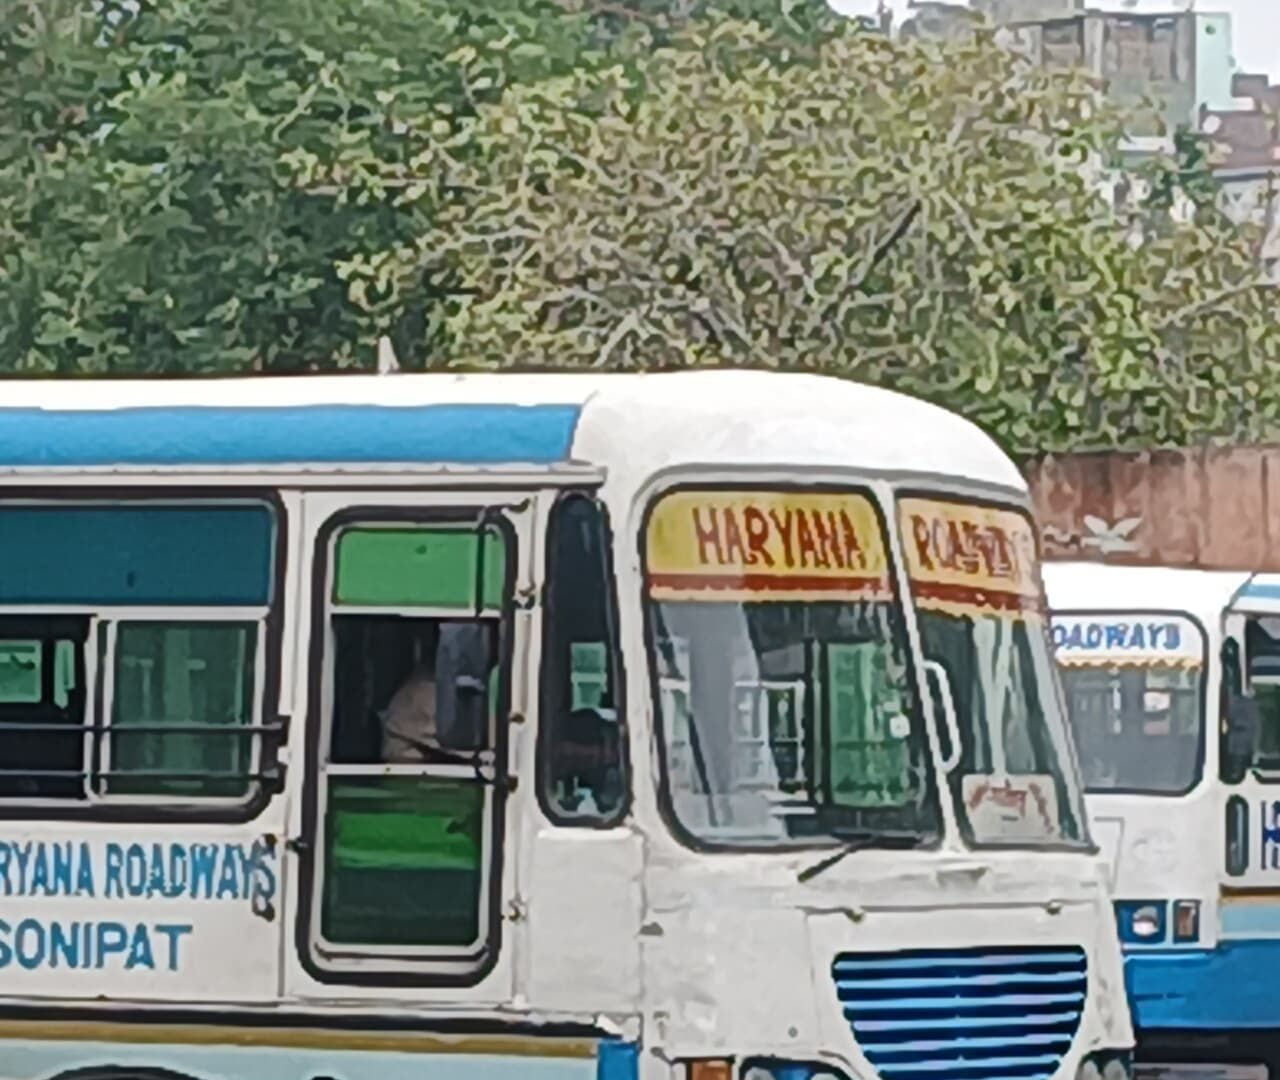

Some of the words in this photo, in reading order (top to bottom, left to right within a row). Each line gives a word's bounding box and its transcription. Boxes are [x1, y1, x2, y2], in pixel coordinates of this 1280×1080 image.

[692, 506, 869, 569] HARYANA
[1050, 622, 1181, 650] OADWAYS
[104, 840, 277, 901] ROADWAYS
